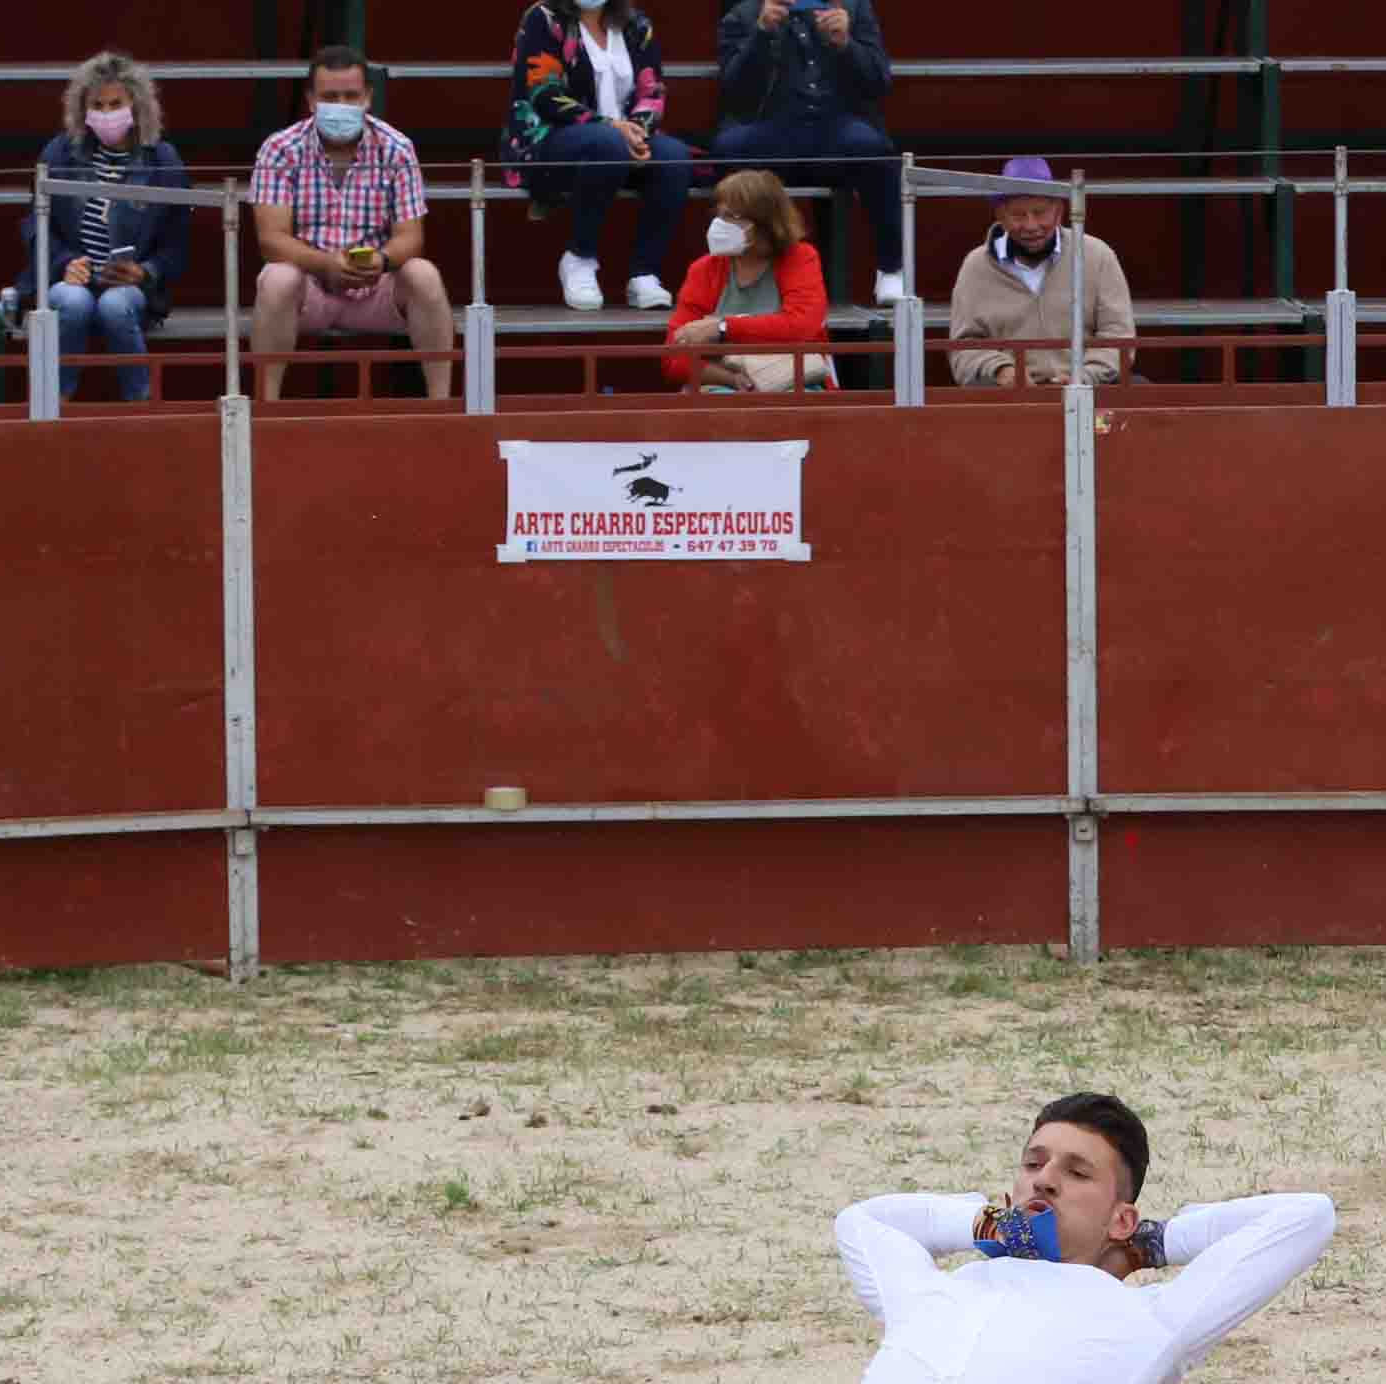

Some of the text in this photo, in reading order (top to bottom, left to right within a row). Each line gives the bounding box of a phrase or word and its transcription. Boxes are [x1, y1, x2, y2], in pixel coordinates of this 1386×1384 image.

[513, 504, 794, 535] ARTE CHARRO ESPECTÁCULOS
[541, 540, 565, 552] ARTE
[566, 540, 600, 552] CHARRO
[687, 540, 713, 552] 647
[717, 540, 734, 552] 47
[739, 540, 757, 552] 39
